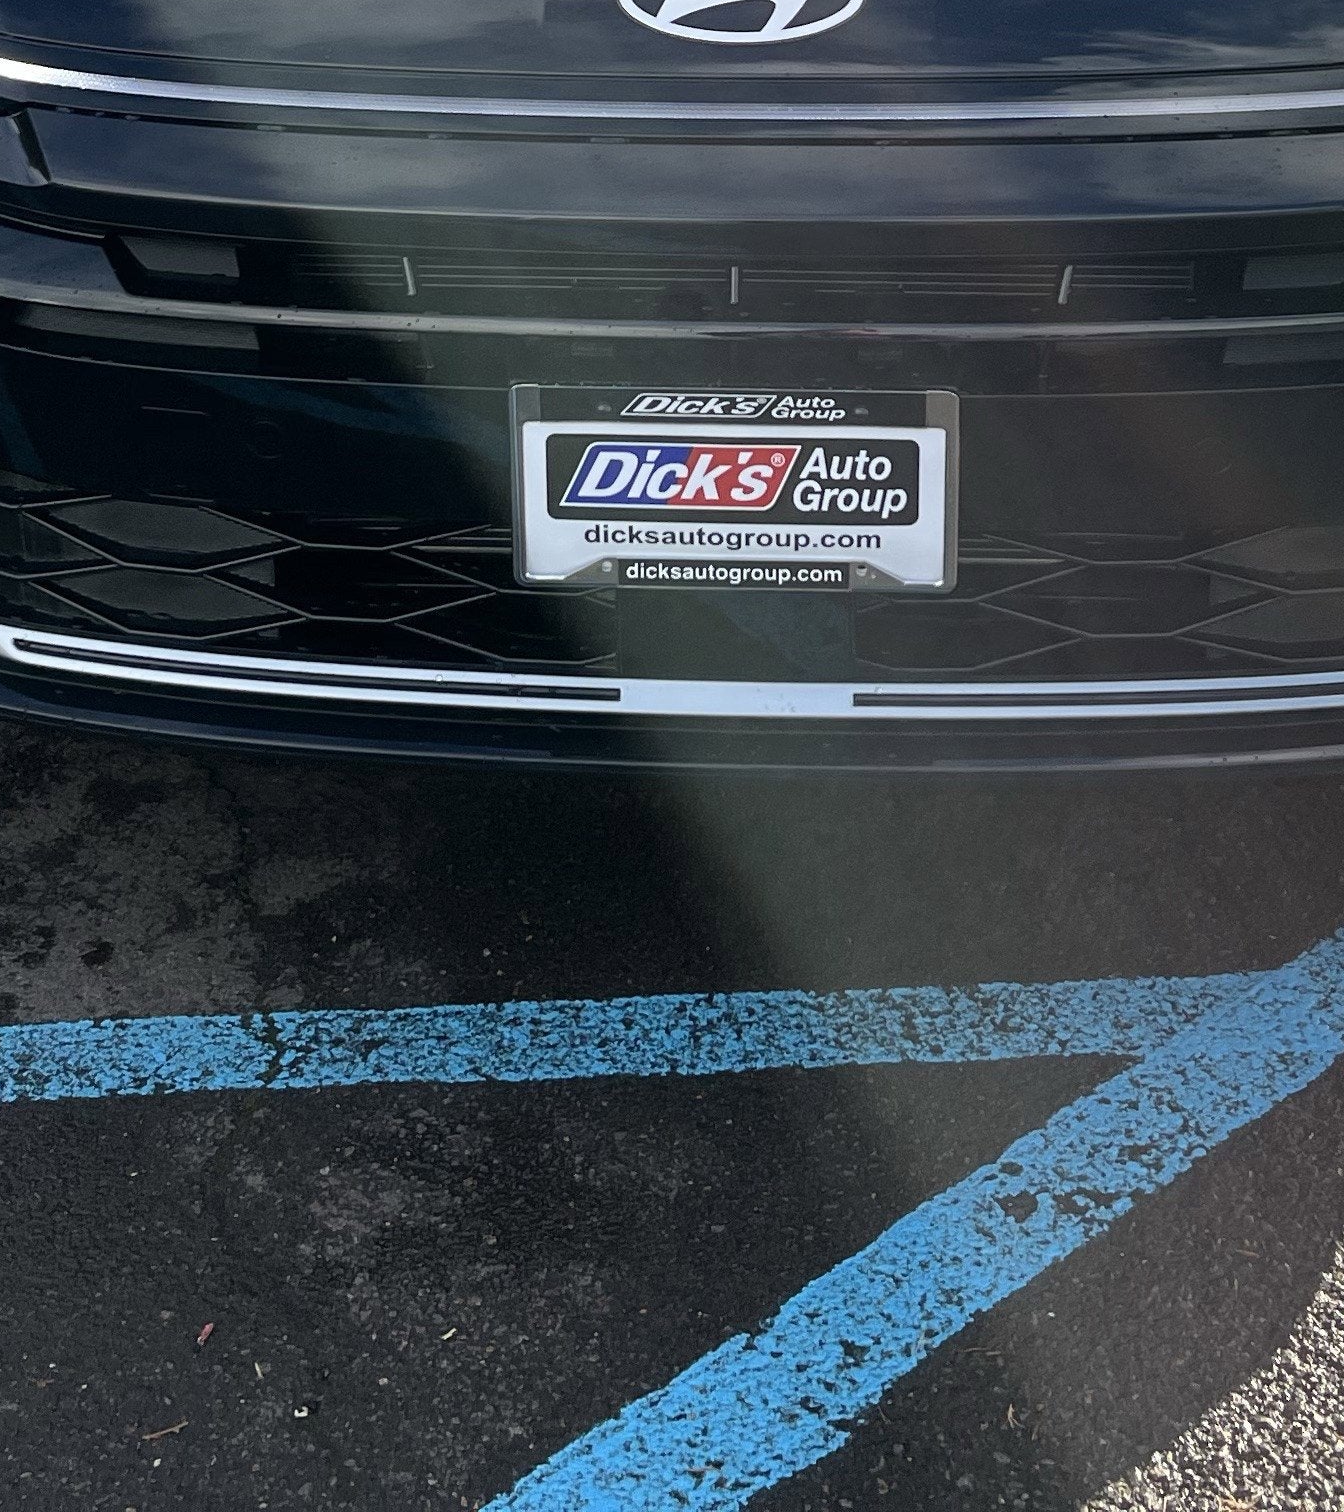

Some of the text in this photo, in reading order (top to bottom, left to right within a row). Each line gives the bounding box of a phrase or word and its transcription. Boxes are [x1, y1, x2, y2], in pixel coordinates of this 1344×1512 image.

[637, 395, 836, 416] Dick's Auto
[771, 406, 846, 422] Group
[577, 447, 892, 502] Dick's Auto
[792, 481, 908, 519] Group
[584, 524, 882, 551] dicksautogroup.com
[625, 562, 843, 585] dicksautogroup.com
